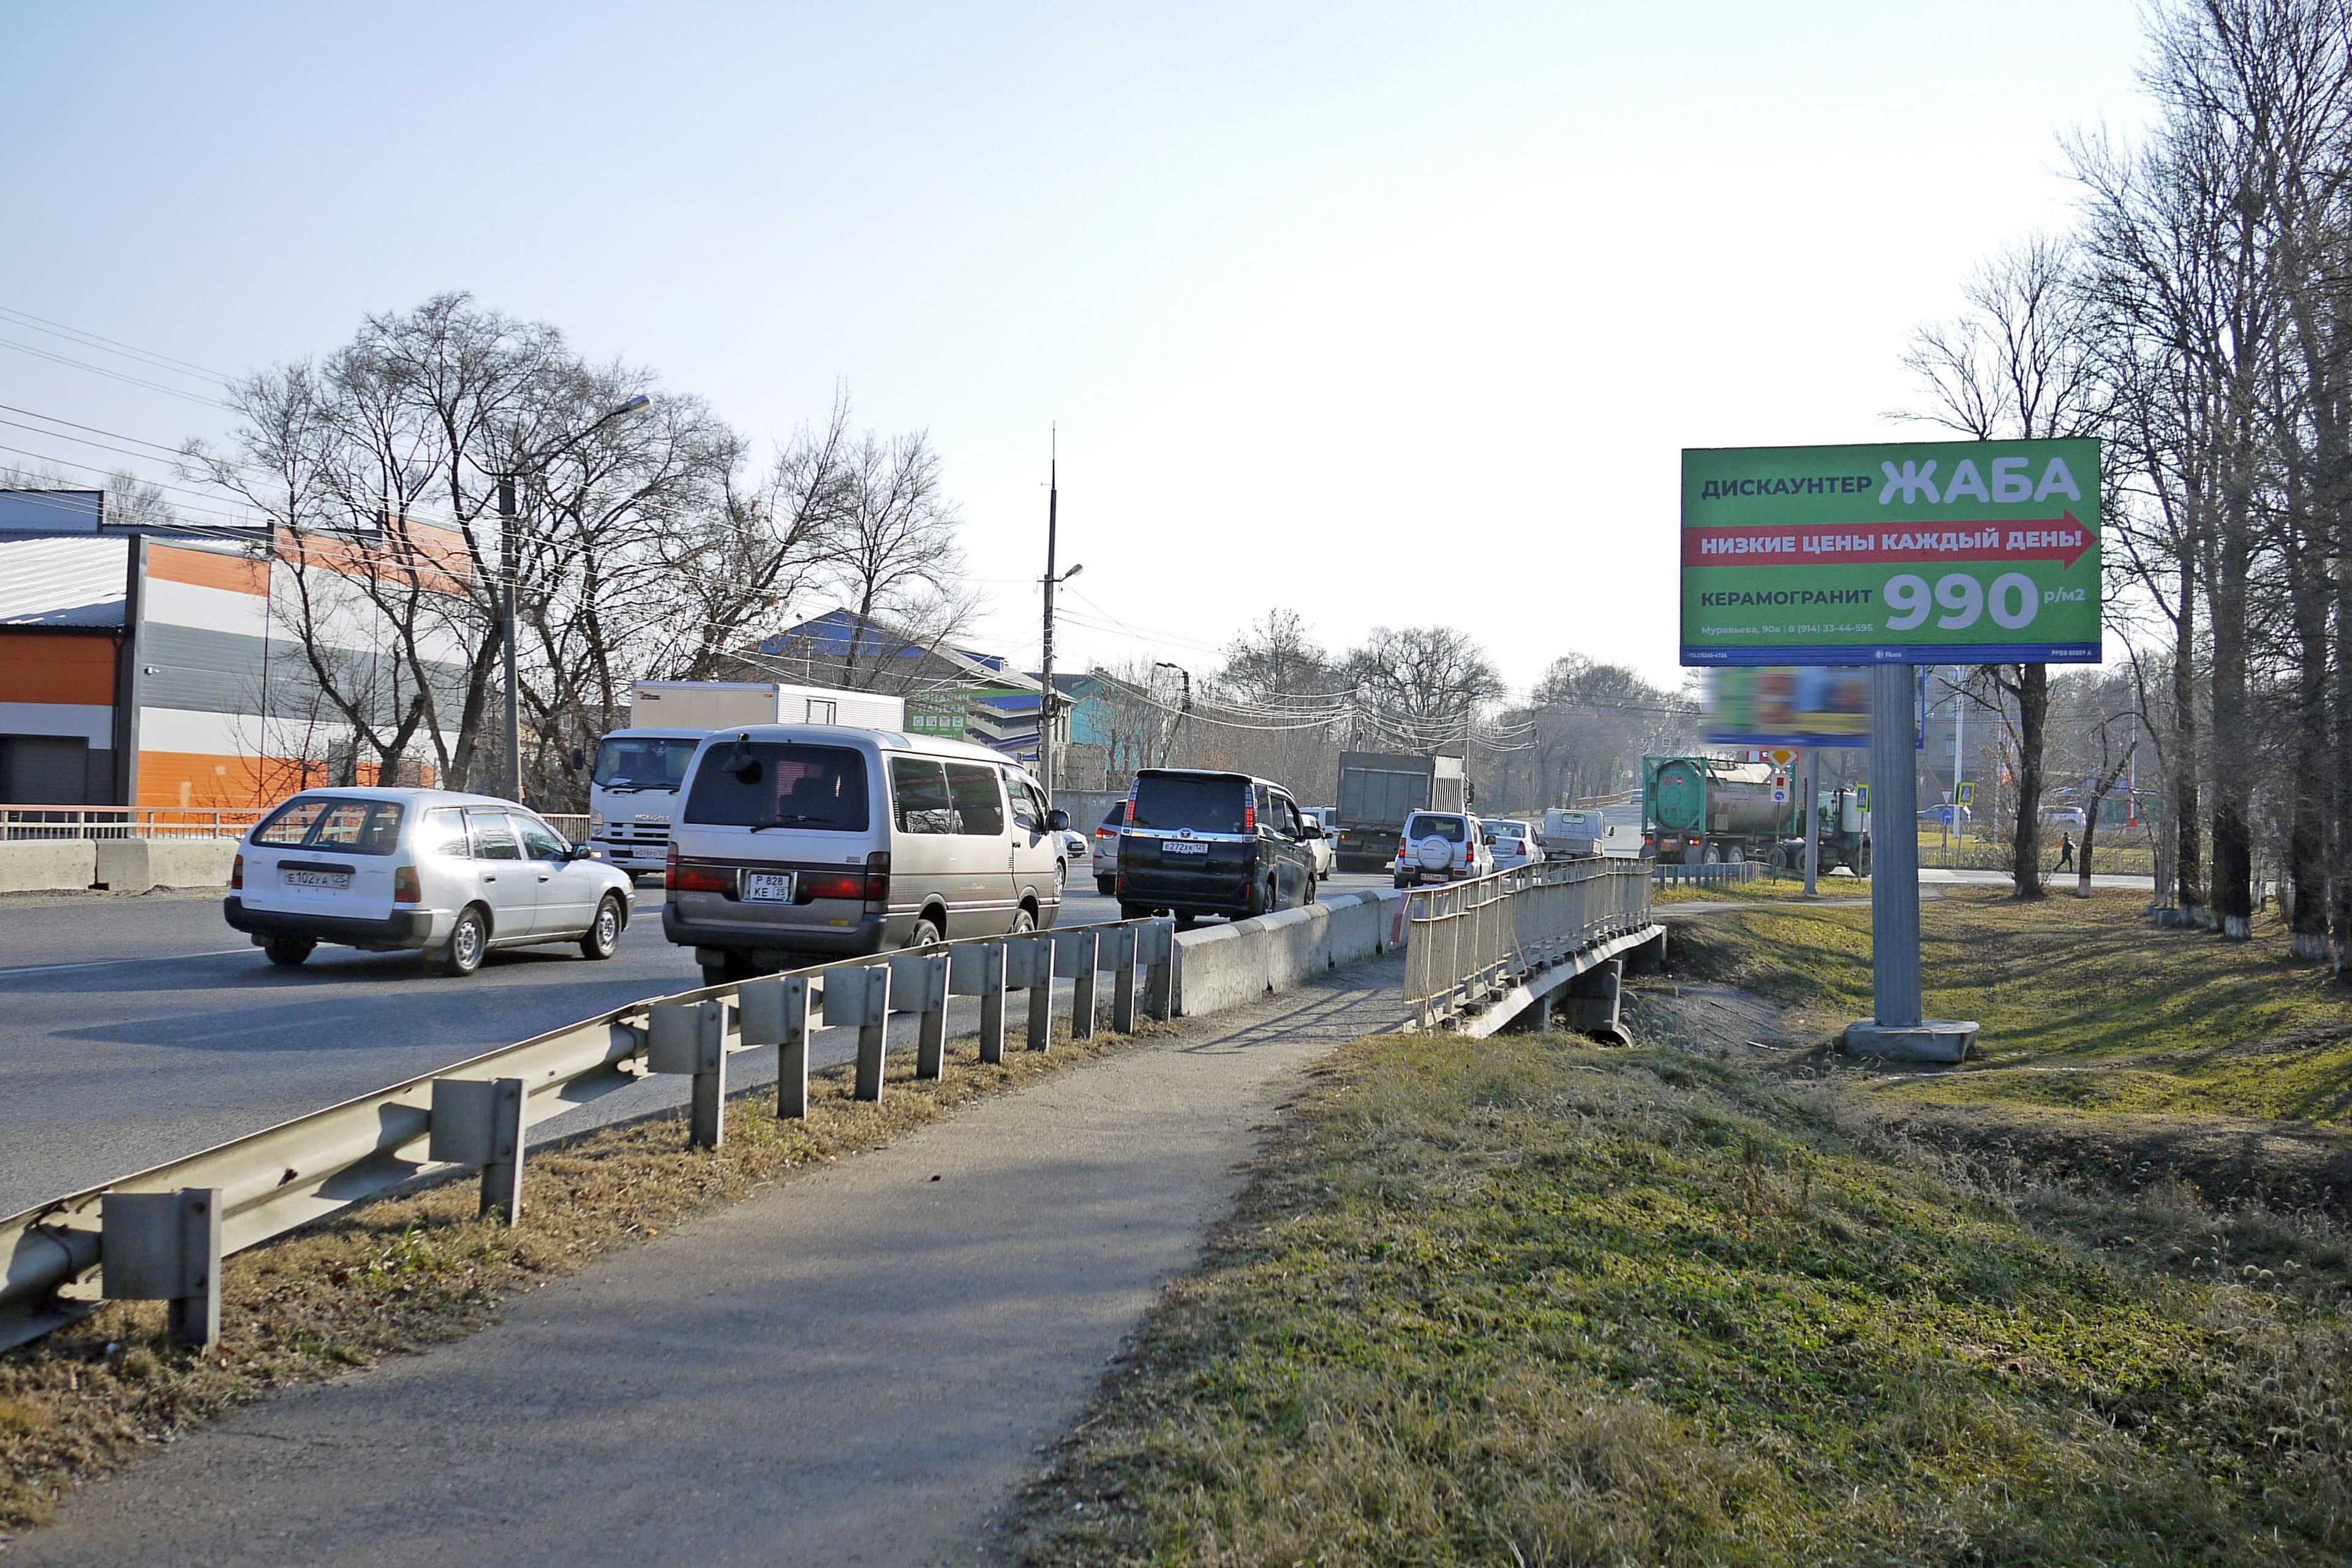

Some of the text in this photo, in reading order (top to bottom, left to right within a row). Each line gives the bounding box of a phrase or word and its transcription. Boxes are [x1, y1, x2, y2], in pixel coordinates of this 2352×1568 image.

[1702, 457, 2081, 505] ДИСКАУНТЕР ЖАБА
[1702, 528, 2082, 554] НИЗКИЕ ЦЕНЫ КАЖДЫЙ ДЕНЬ!
[1702, 590, 1872, 606] КЕРАМОГРАНИТ
[1883, 573, 2038, 630] 990
[766, 876, 783, 886] 828
